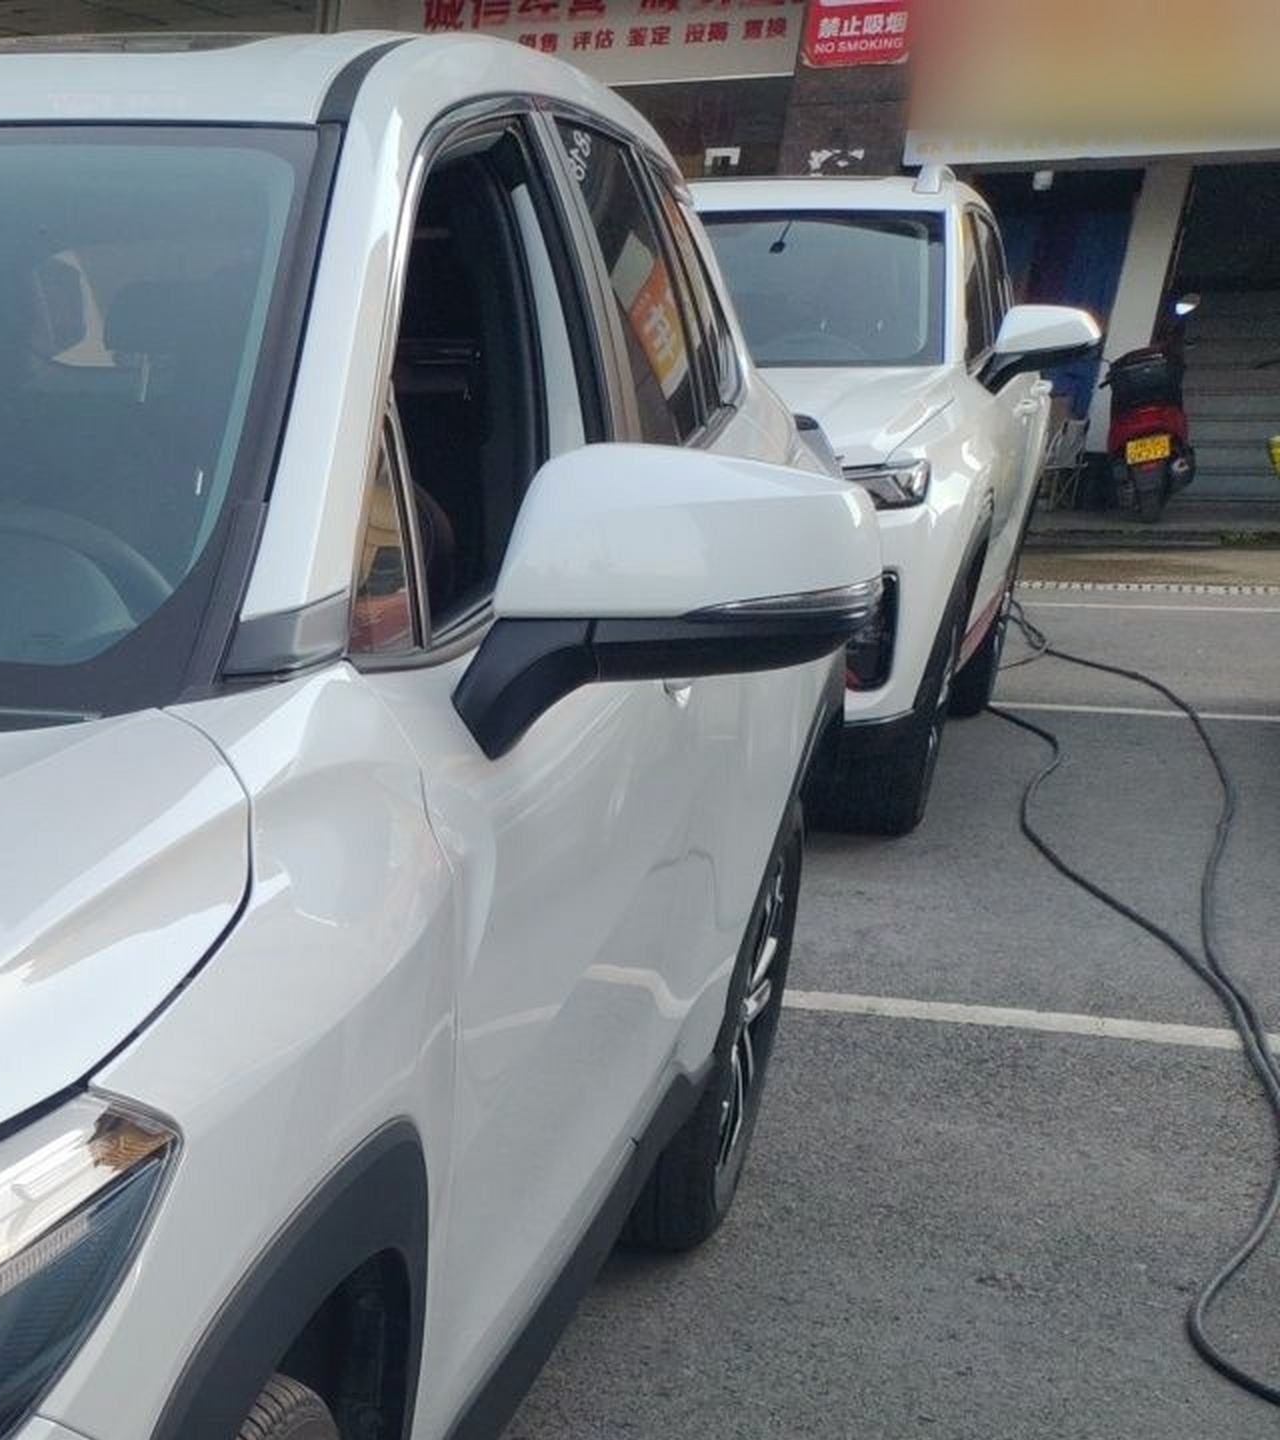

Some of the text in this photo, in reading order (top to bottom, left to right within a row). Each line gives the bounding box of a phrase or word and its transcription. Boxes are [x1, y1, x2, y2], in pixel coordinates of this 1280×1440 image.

[817, 12, 908, 39] 禁止吸烟
[572, 29, 614, 50] 评估
[814, 37, 904, 54] NO SMOKING
